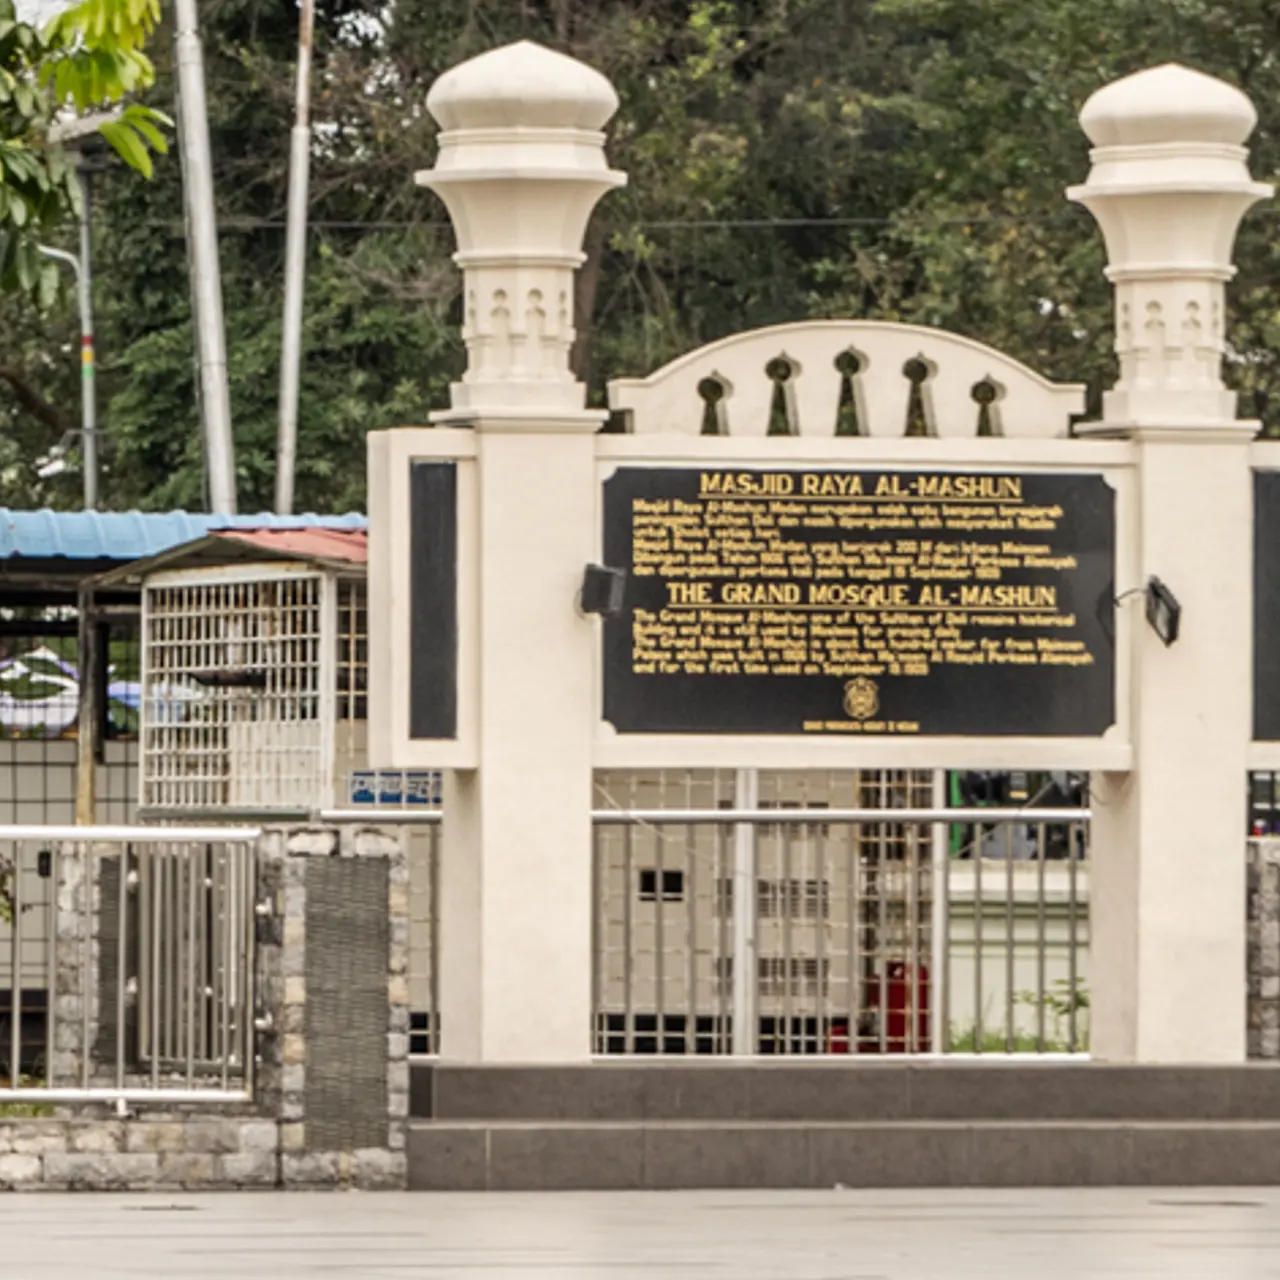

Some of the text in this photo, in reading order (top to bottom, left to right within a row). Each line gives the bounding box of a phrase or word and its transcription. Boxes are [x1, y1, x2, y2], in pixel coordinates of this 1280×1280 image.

[699, 472, 1023, 497] MASJID RAYA AL-MASHUN
[666, 582, 1056, 607] THE GRAND MOSQUE AL-MASHUN
